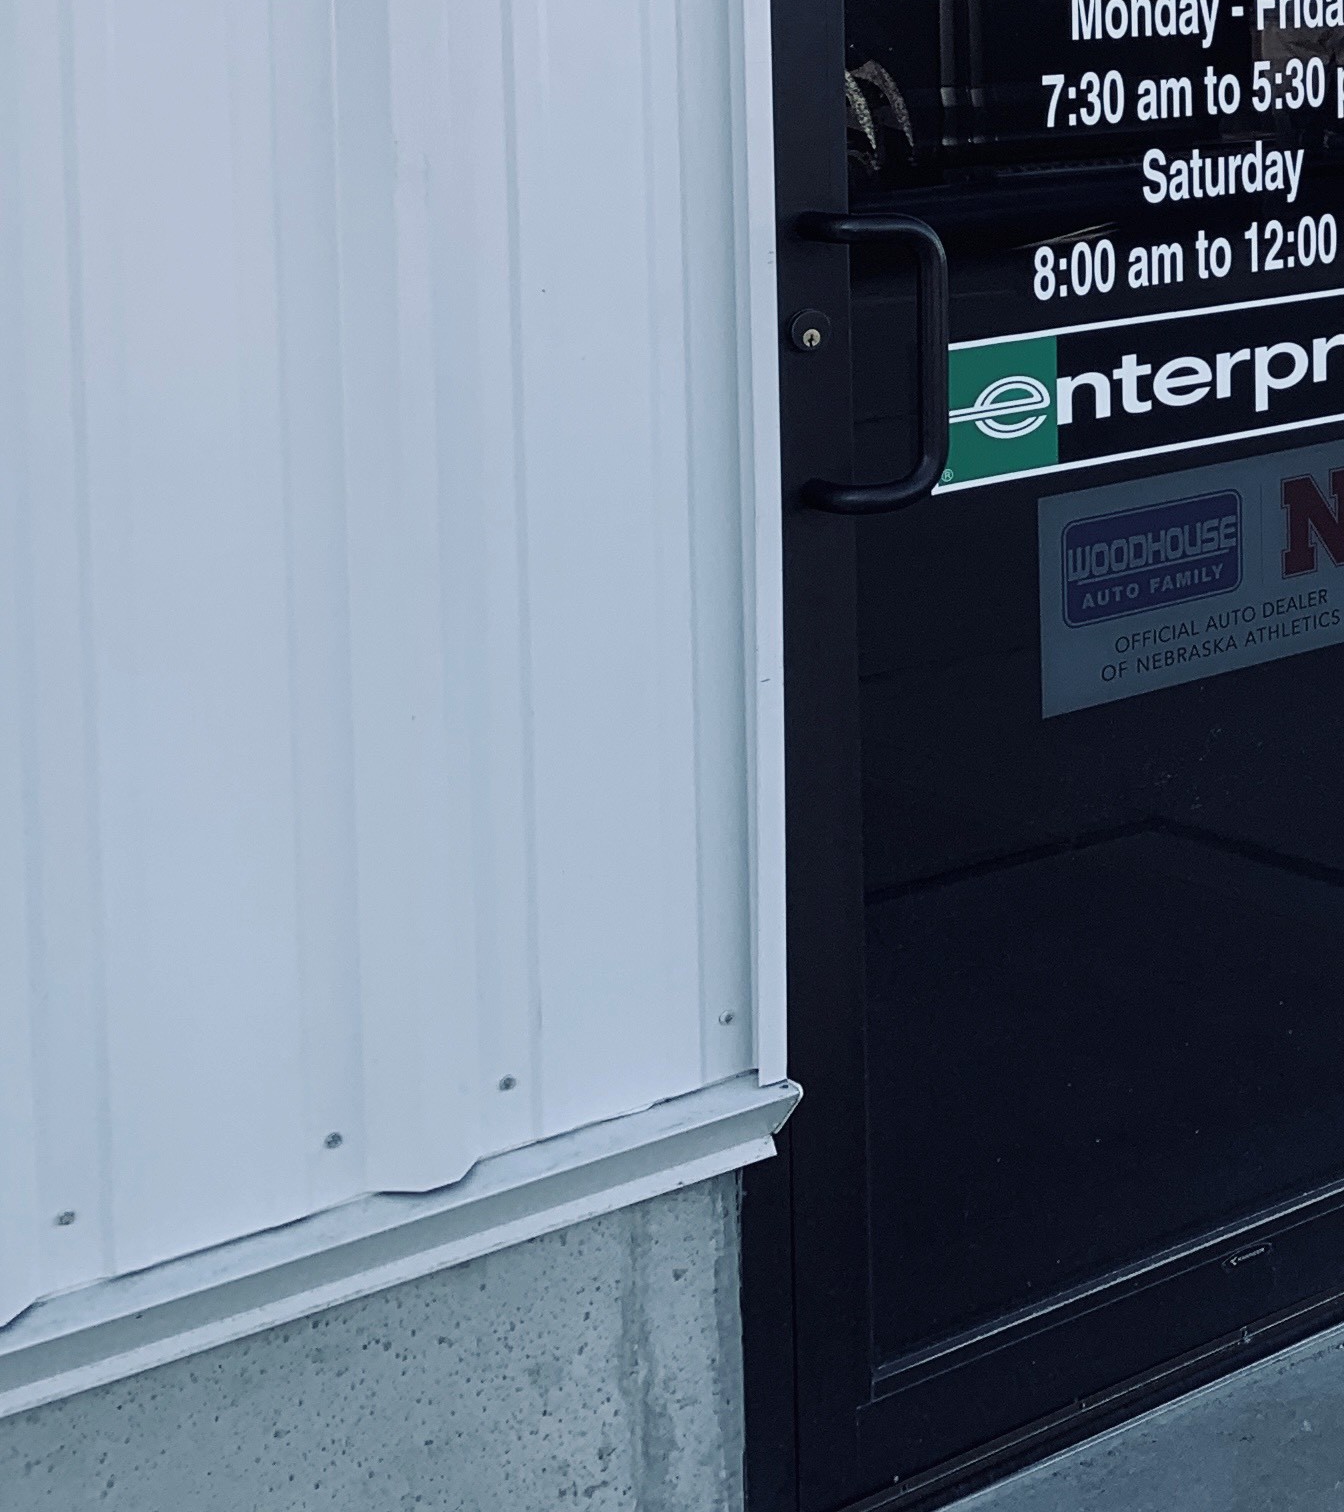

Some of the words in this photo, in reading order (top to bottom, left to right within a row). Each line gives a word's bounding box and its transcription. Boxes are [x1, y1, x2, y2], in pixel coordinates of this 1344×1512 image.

[1042, 70, 1125, 127] 7:30
[1137, 75, 1192, 121] am
[1204, 65, 1241, 115] to
[1252, 57, 1325, 112] 5:30
[1142, 140, 1305, 203] Saturday
[1033, 239, 1115, 300] 8:00
[1128, 242, 1184, 289] am
[1195, 230, 1232, 279] to
[1244, 213, 1337, 273] 12:00
[1068, 515, 1237, 581] WOODHOUSE
[1082, 584, 1140, 610] AUTO
[1150, 564, 1225, 594] FAMILY
[1101, 661, 1129, 682] OF
[1137, 636, 1238, 674] NEBRASKA
[1244, 609, 1341, 647] ATHLETICS
[1115, 617, 1199, 654] OFFICIAL
[1205, 606, 1256, 632] AUTO
[1263, 589, 1328, 619] DEALER
